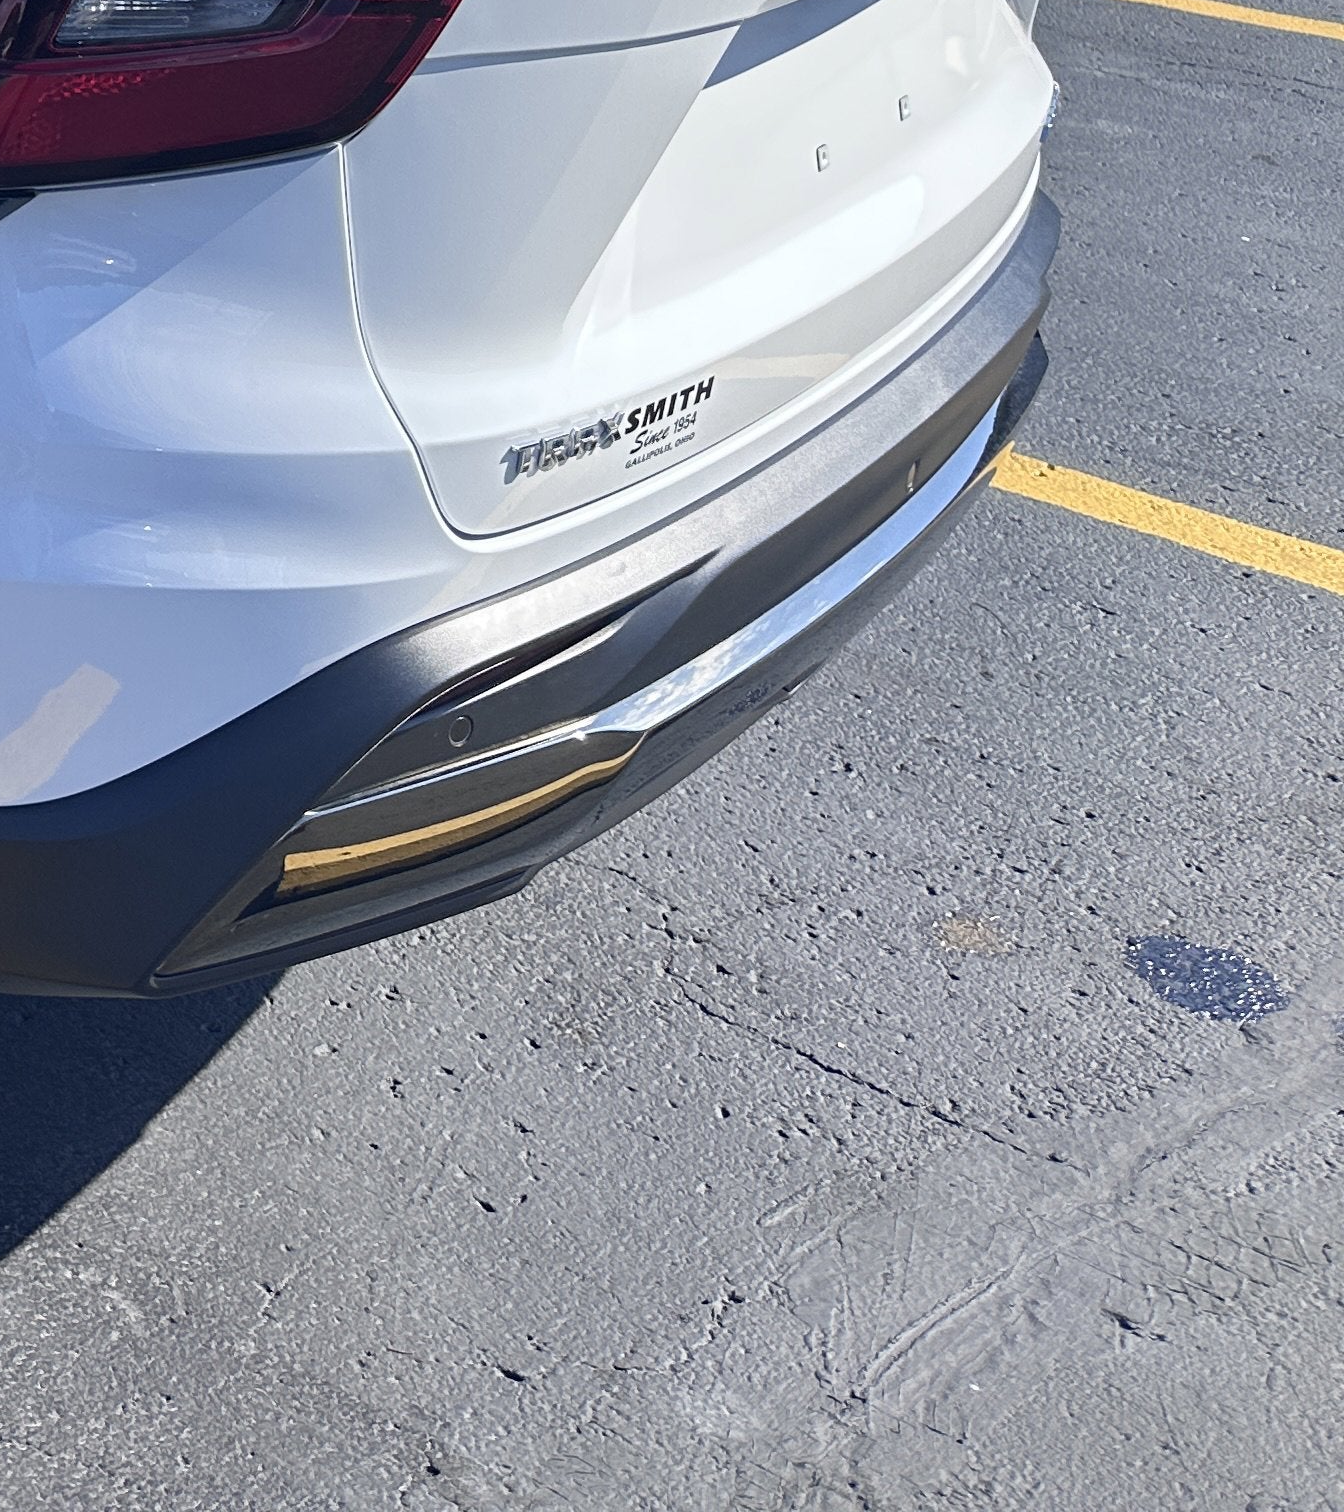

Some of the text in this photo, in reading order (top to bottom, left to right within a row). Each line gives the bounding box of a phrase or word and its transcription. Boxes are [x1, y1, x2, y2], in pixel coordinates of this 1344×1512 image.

[624, 376, 715, 435] SMITH
[629, 410, 699, 455] Since 1954
